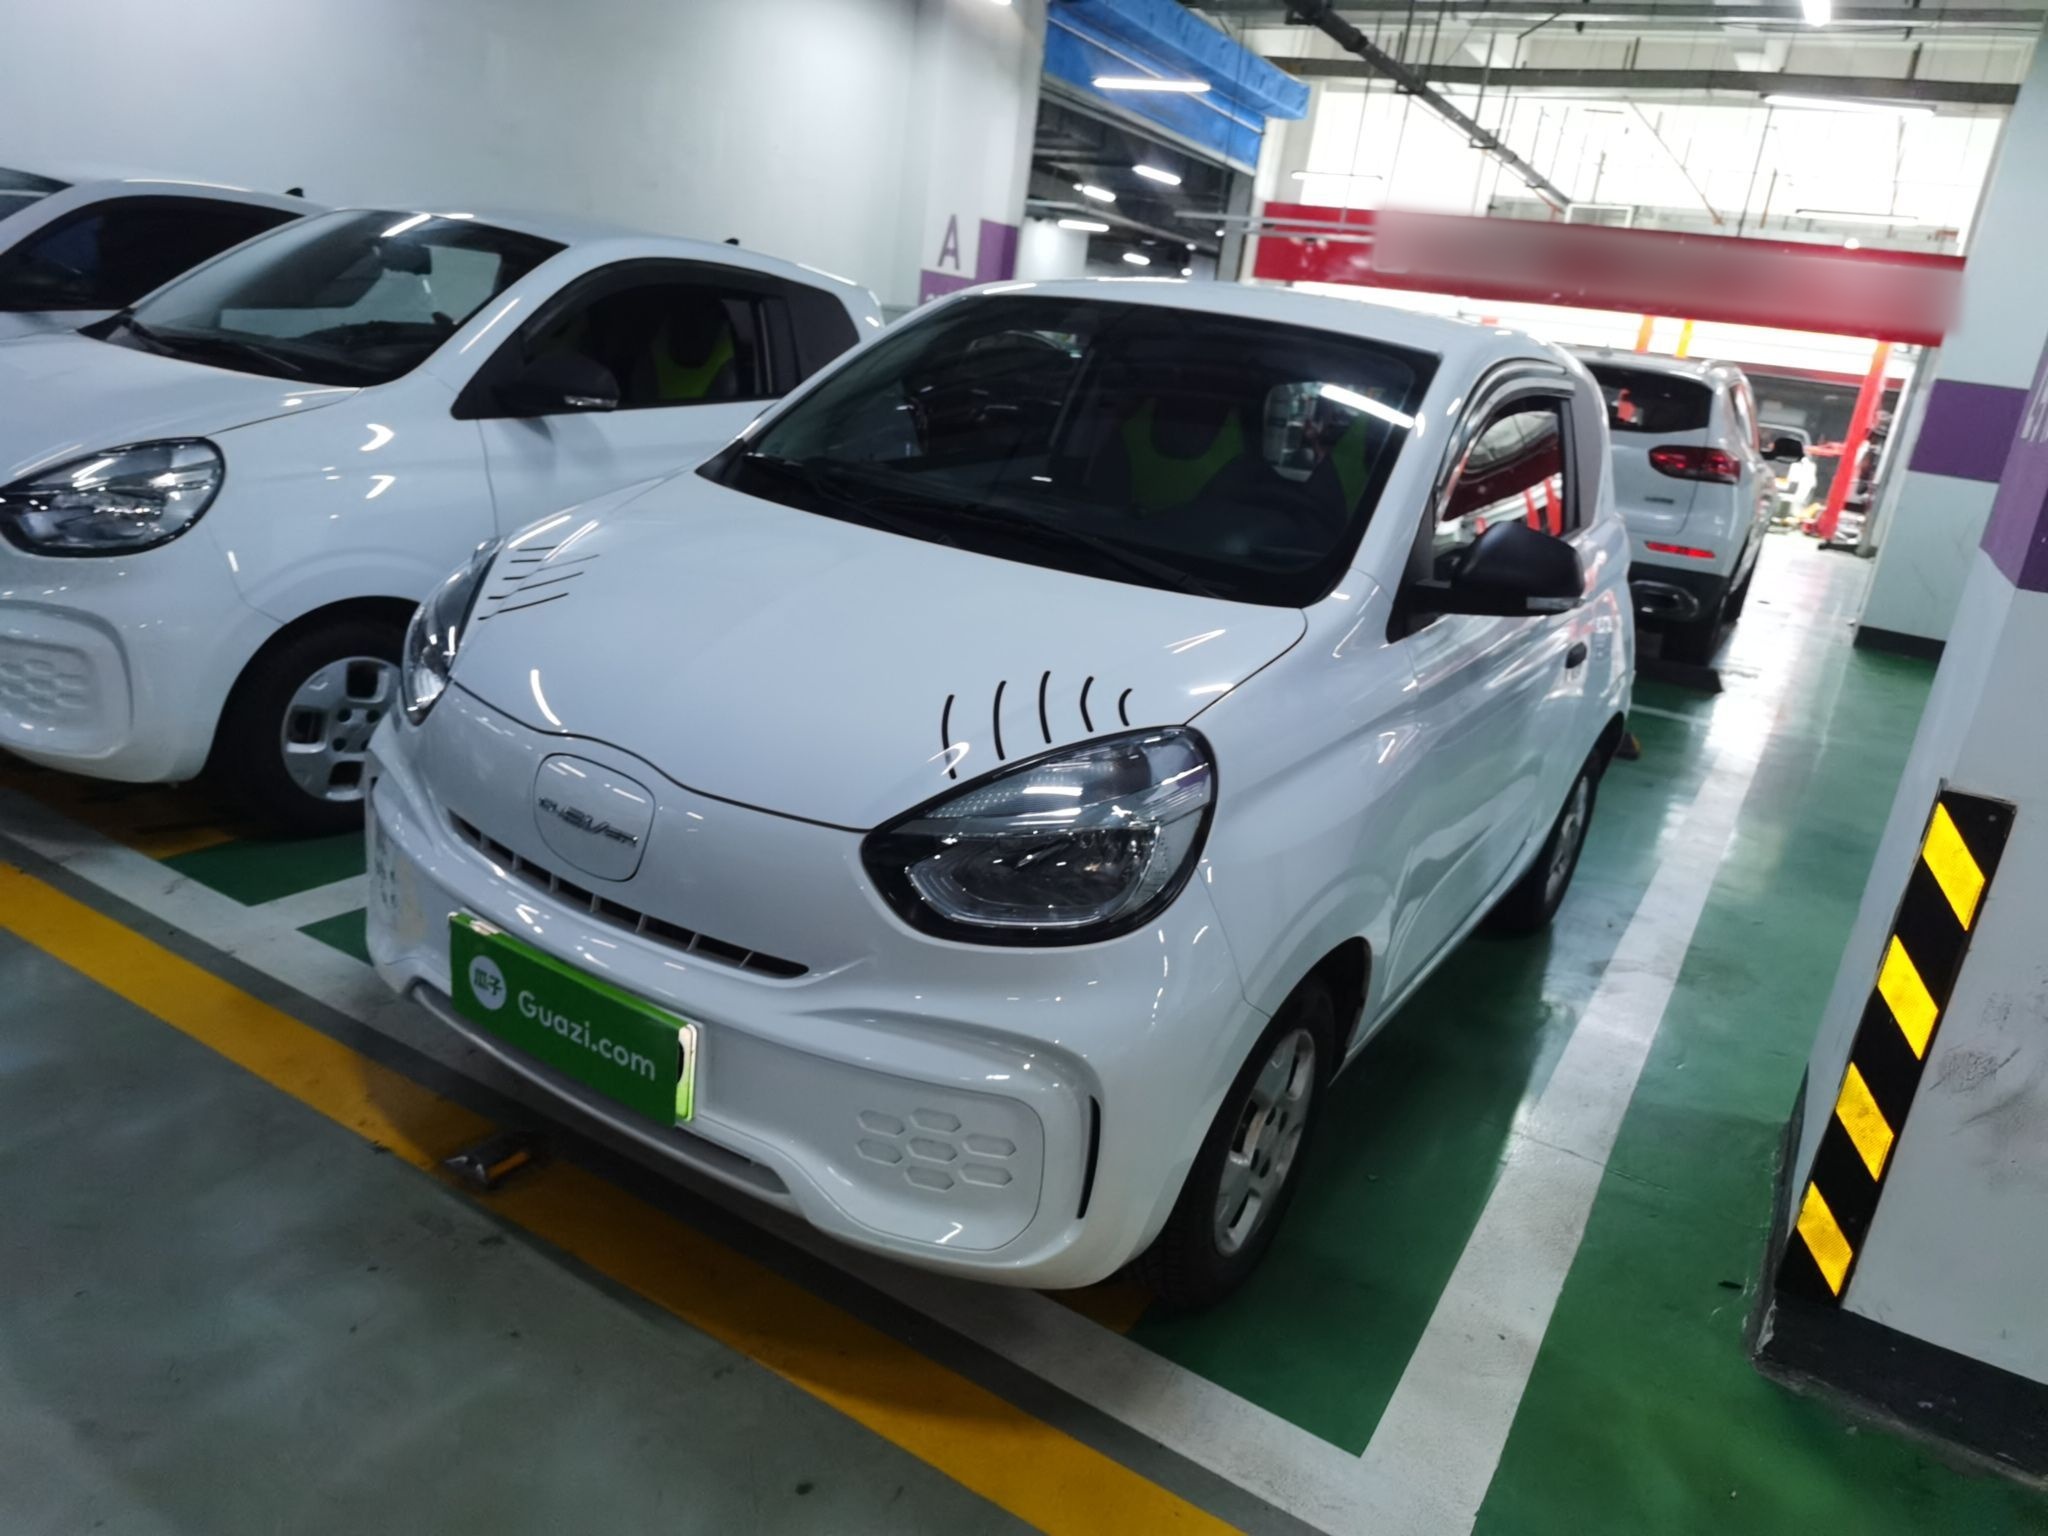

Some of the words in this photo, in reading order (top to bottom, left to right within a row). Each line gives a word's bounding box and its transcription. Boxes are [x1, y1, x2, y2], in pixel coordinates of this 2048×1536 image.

[937, 213, 960, 270] A
[473, 967, 502, 996] 瓜子
[517, 990, 656, 1081] Guazi.com
